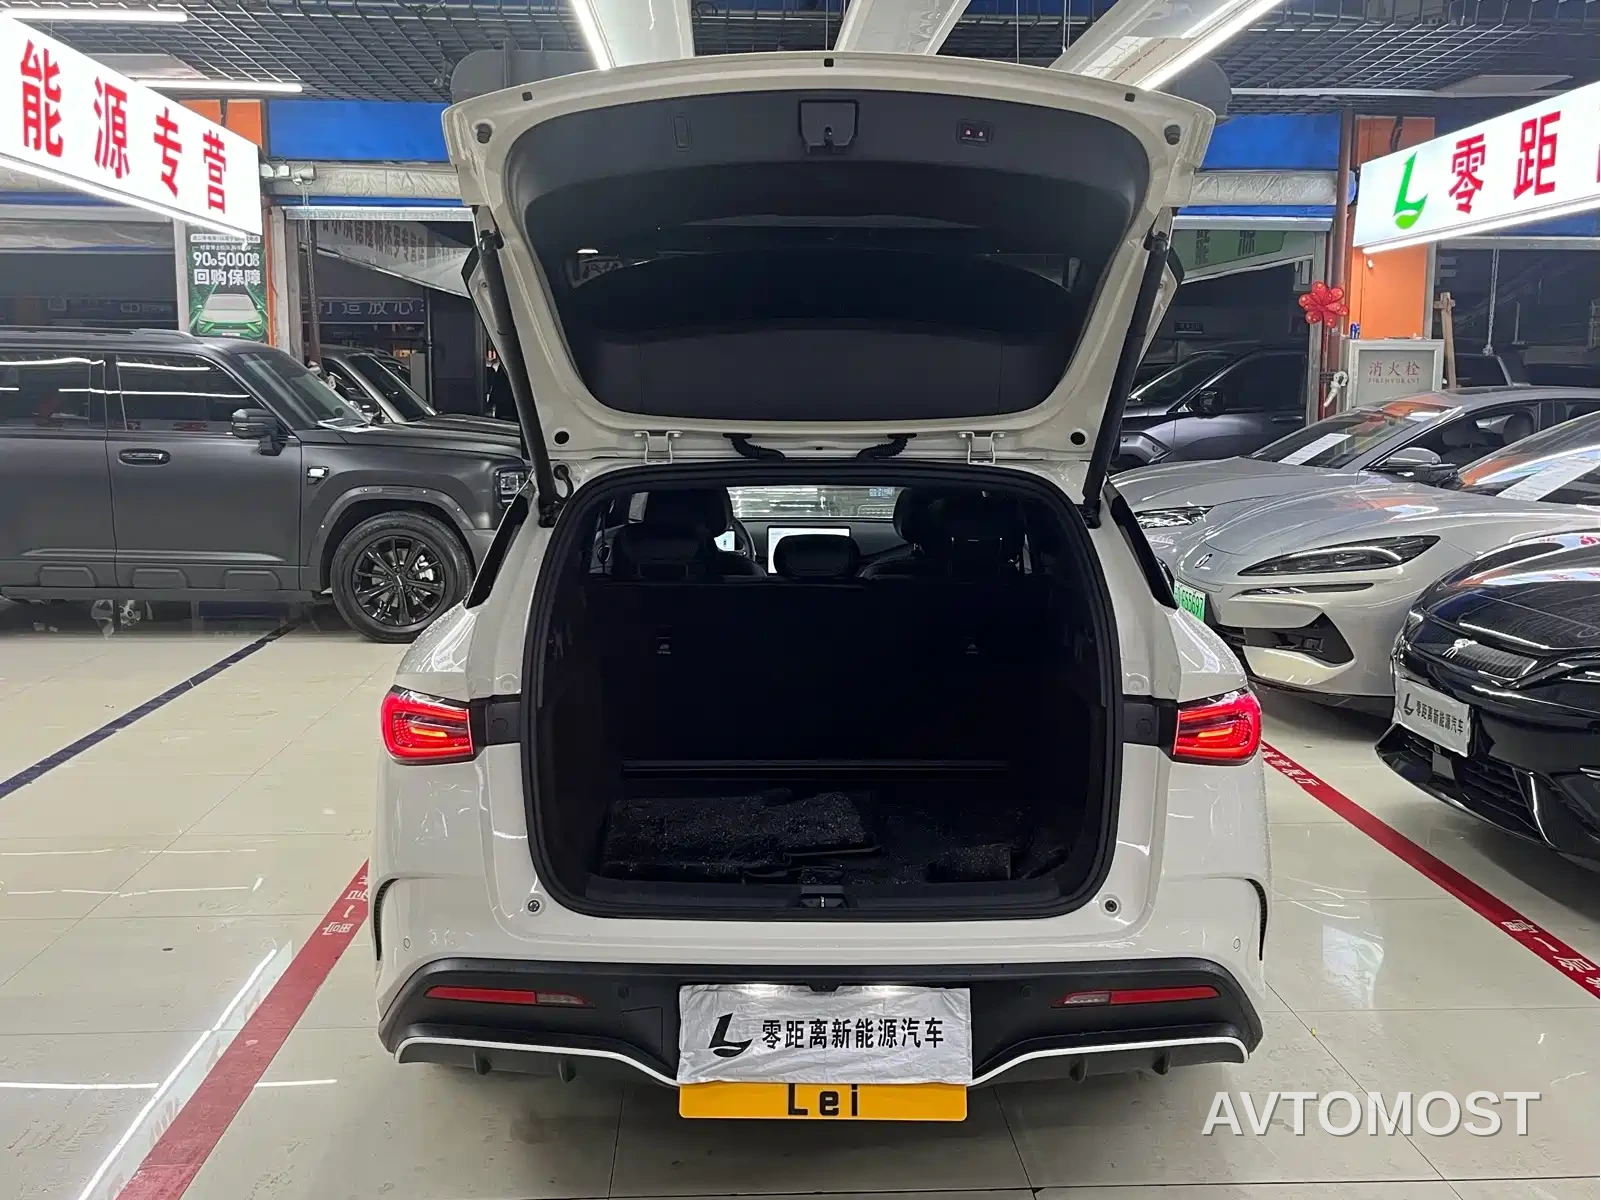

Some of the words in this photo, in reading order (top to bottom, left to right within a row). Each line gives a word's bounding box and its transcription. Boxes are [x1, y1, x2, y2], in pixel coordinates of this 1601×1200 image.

[20, 39, 227, 214] 能源专营
[193, 269, 261, 286] 回购保障
[319, 300, 424, 315] 打造放心
[1368, 360, 1420, 377] 消火栓
[1416, 700, 1465, 737] 零距离新能源汽车
[762, 1017, 944, 1050] 零距离新能源汽车
[787, 1083, 859, 1117] Lei
